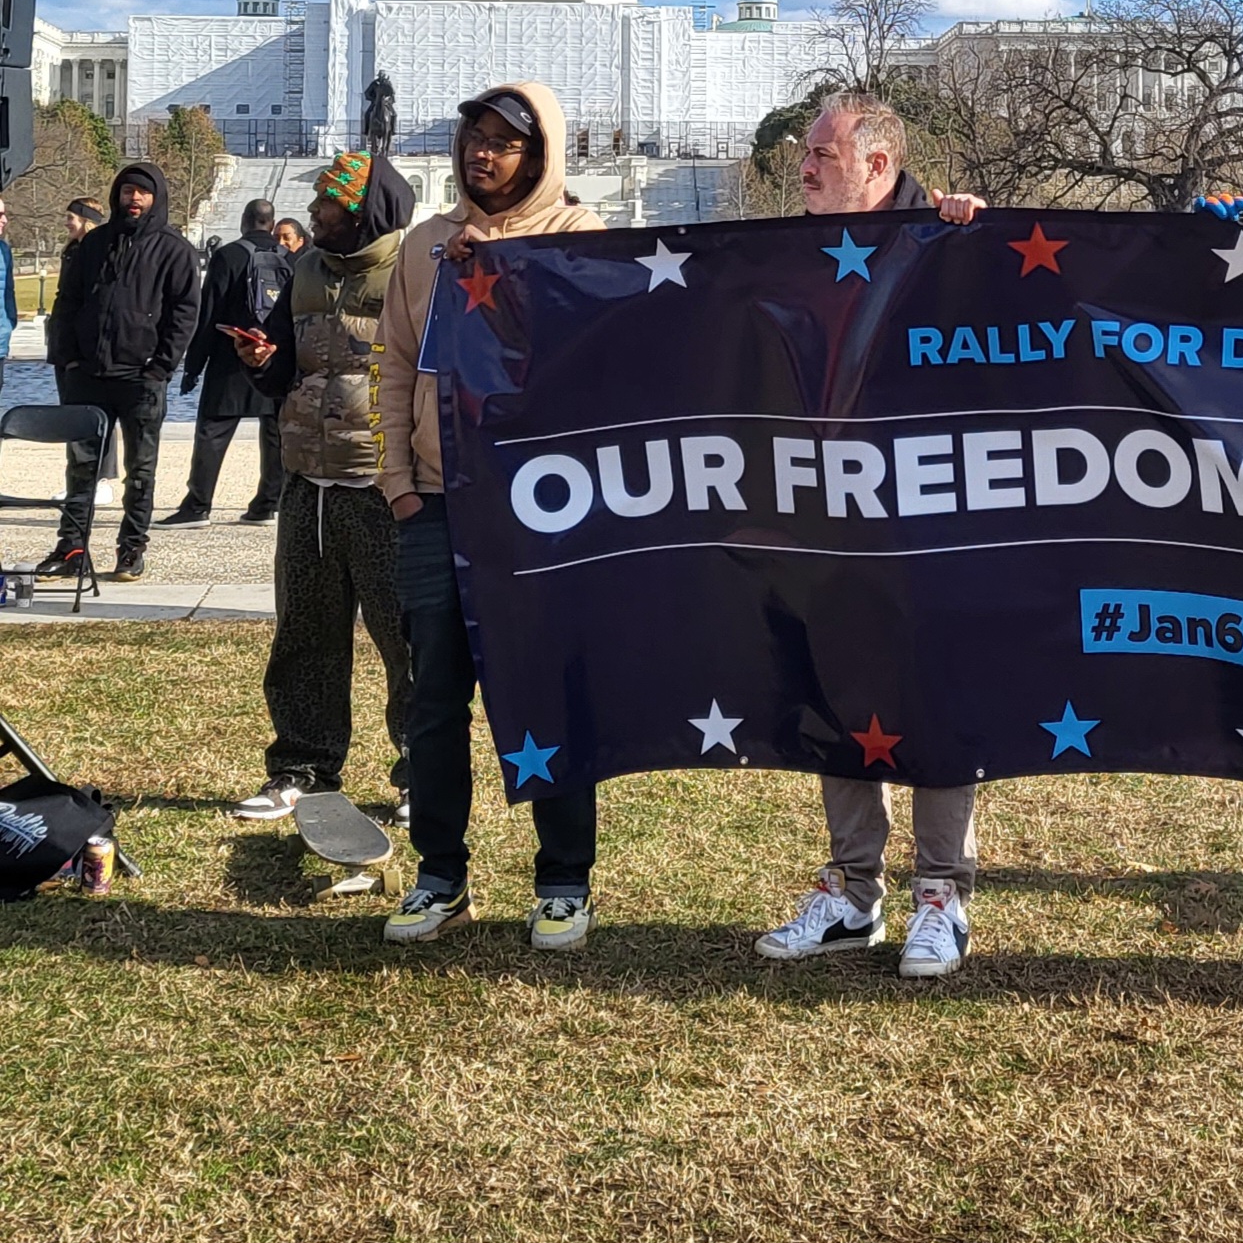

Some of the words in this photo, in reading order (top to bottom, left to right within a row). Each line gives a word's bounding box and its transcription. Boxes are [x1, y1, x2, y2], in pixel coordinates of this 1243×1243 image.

[907, 319, 1075, 366] RALLY
[1091, 320, 1203, 366] FOR
[510, 435, 748, 533] OUR
